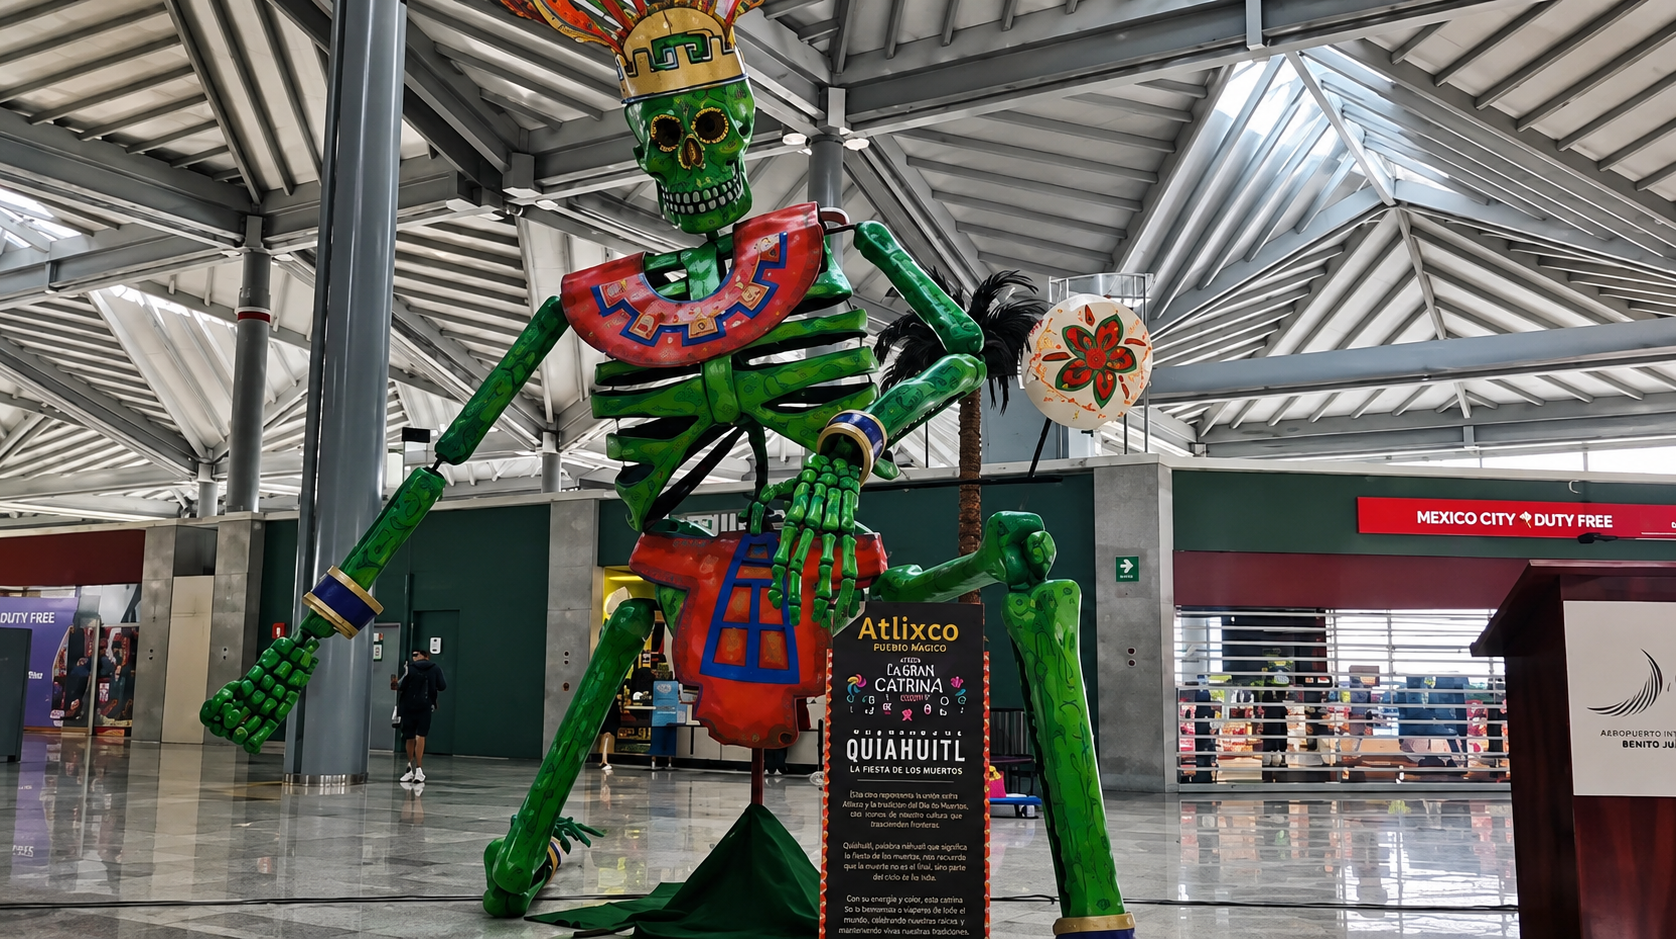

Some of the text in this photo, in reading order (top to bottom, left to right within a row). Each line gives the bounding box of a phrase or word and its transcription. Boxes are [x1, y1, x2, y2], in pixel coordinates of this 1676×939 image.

[1417, 510, 1613, 528] MEXICO CITY DUTY FREE
[0, 612, 55, 624] DUTY FREE
[857, 616, 960, 641] Atlixco
[887, 663, 935, 677] LA GRAN
[875, 677, 943, 693] CATRINA
[1600, 729, 1662, 738] AEROPUERTO
[1622, 740, 1660, 748] BENITO
[849, 765, 860, 773] LA
[862, 766, 890, 774] FIESTA
[905, 766, 921, 775] LOS
[923, 767, 963, 775] MUERTOS
[846, 894, 861, 903] Con
